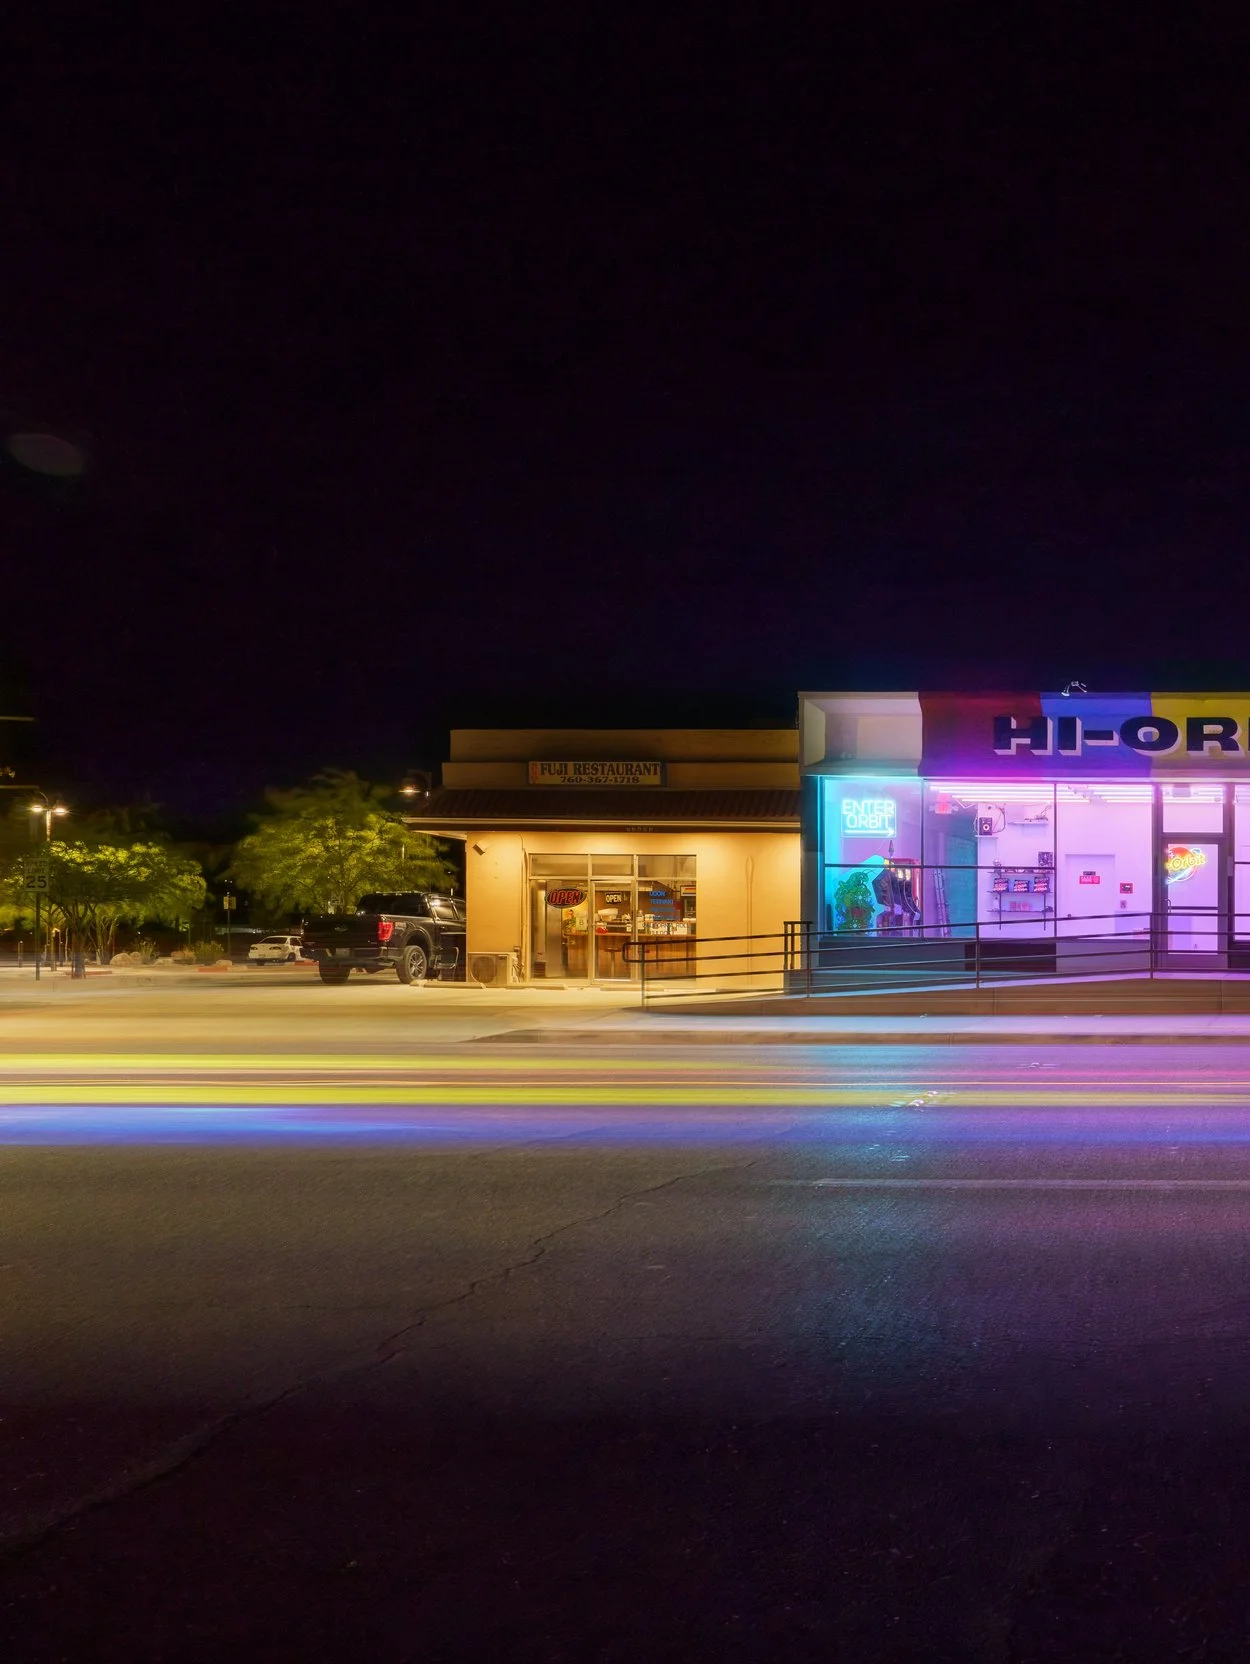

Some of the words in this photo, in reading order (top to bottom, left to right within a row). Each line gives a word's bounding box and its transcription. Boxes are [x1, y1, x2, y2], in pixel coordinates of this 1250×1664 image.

[540, 762, 569, 776] FUJI
[573, 762, 660, 776] RESTAURANT
[842, 800, 895, 815] ENTER
[846, 814, 893, 829] ORBIT
[26, 875, 47, 888] 25
[550, 890, 581, 905] OPEN
[605, 894, 622, 903] OPEN
